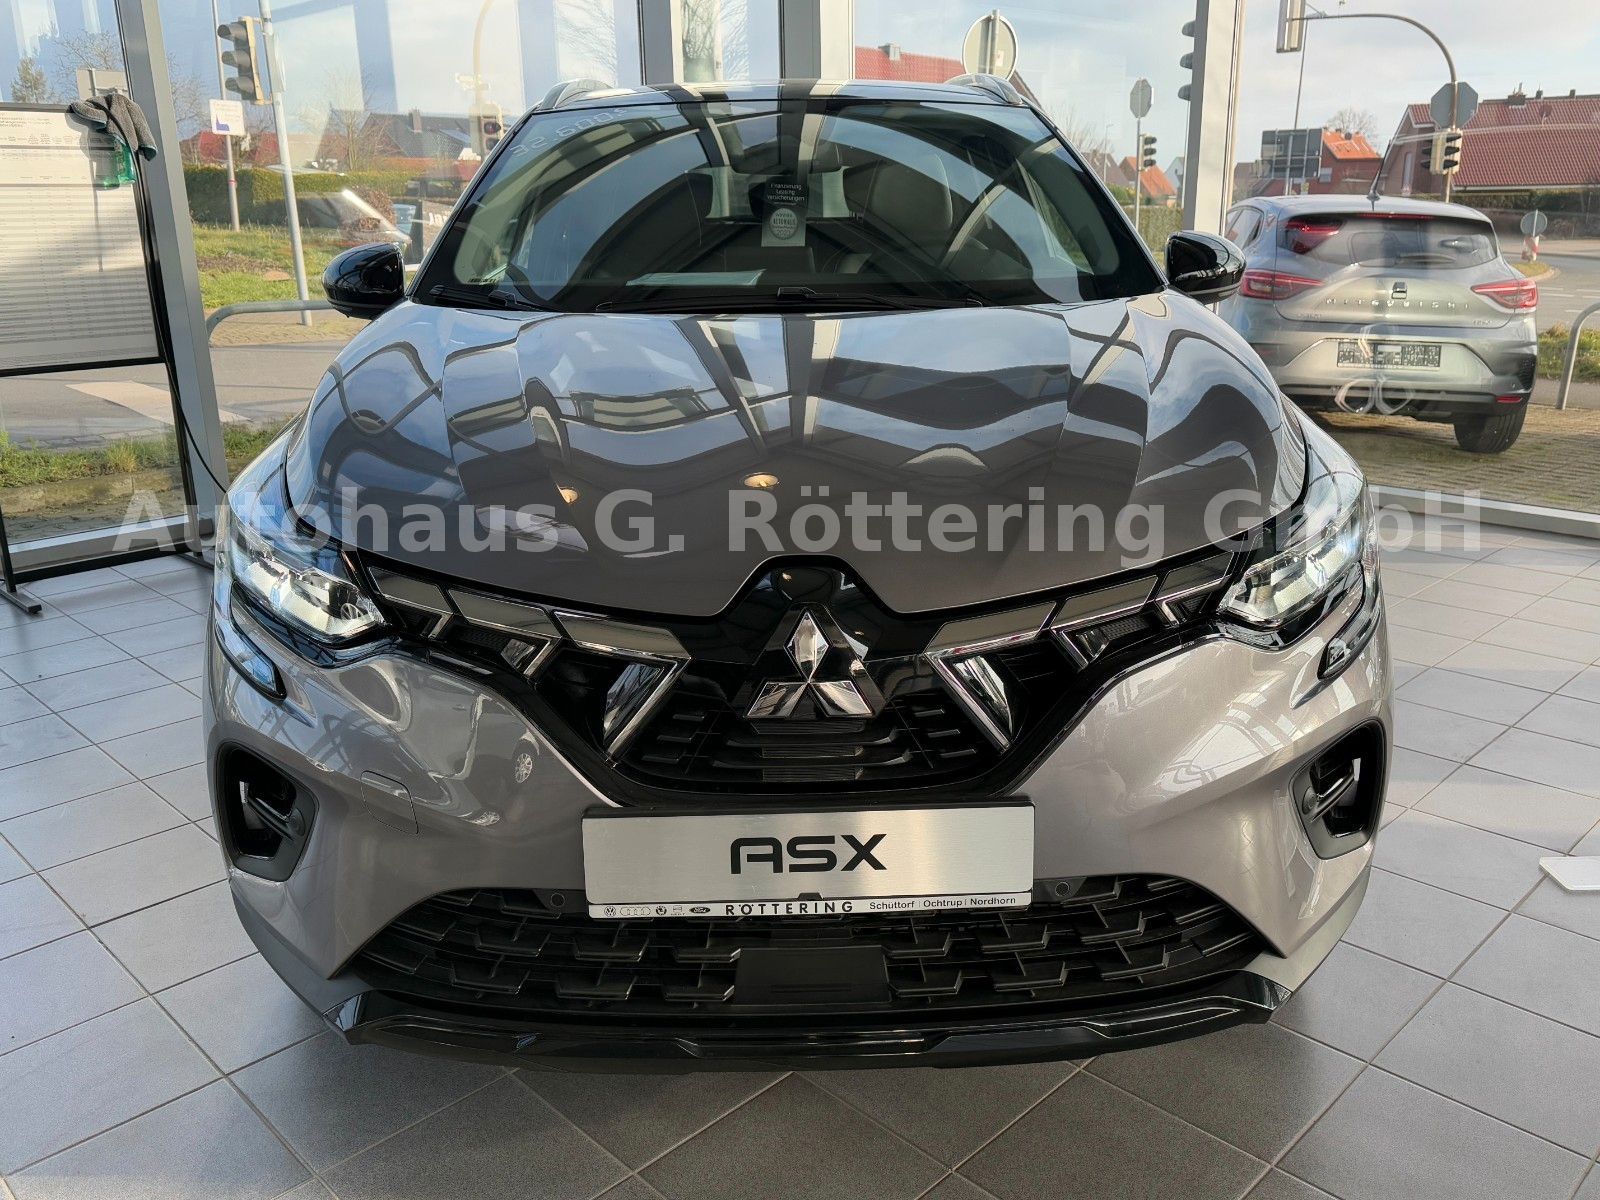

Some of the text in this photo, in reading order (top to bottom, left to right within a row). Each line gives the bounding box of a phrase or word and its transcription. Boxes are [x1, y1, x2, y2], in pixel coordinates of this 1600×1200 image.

[730, 833, 888, 874] ASX
[725, 900, 853, 916] RÖTTERING
[869, 900, 914, 910] Schüttorf
[923, 898, 962, 909] Ochtrup
[970, 896, 1016, 906] Nordhorn
